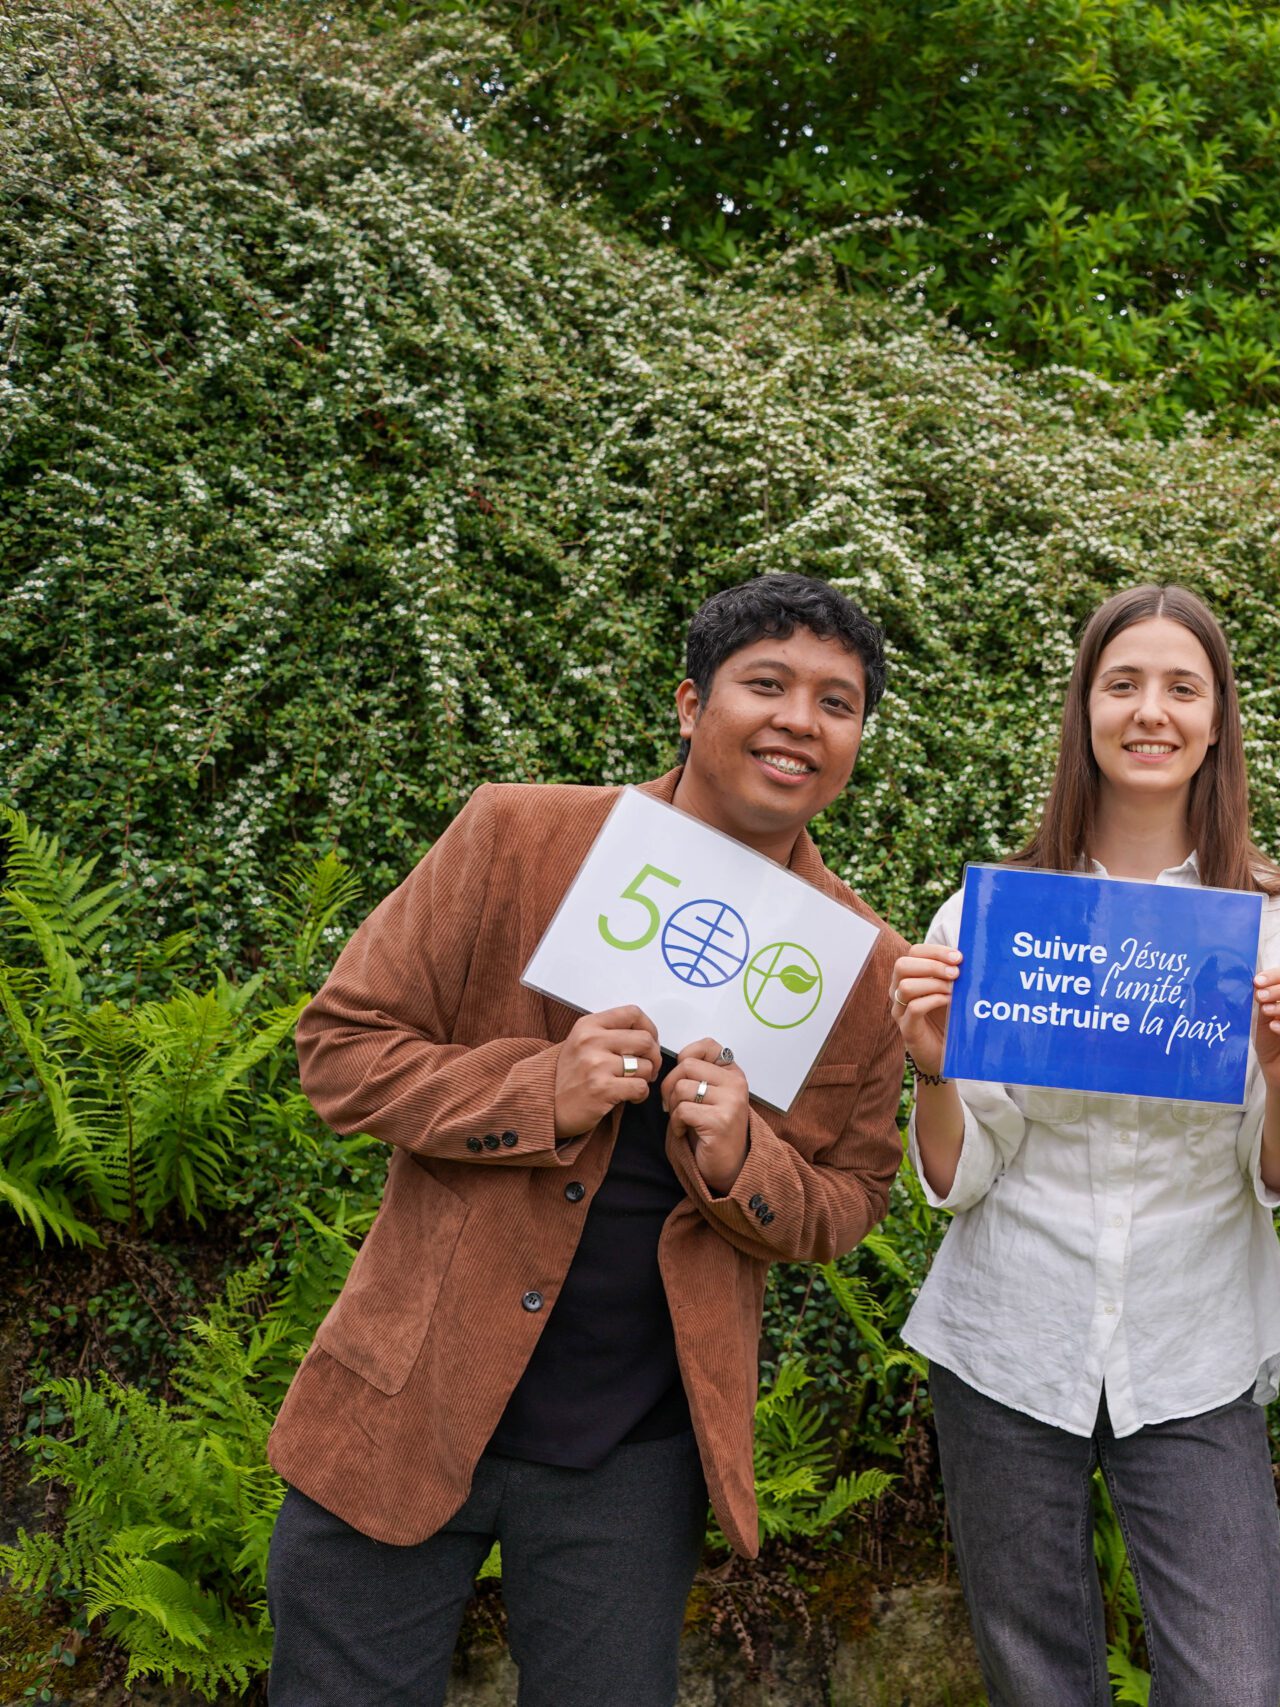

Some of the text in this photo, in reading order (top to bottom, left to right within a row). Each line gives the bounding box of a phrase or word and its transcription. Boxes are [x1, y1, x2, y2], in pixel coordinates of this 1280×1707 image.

[1012, 931, 1191, 976] Suivre Jésus,
[1019, 962, 1187, 1009] vivre l'unité,
[973, 998, 1231, 1055] construire la paix
